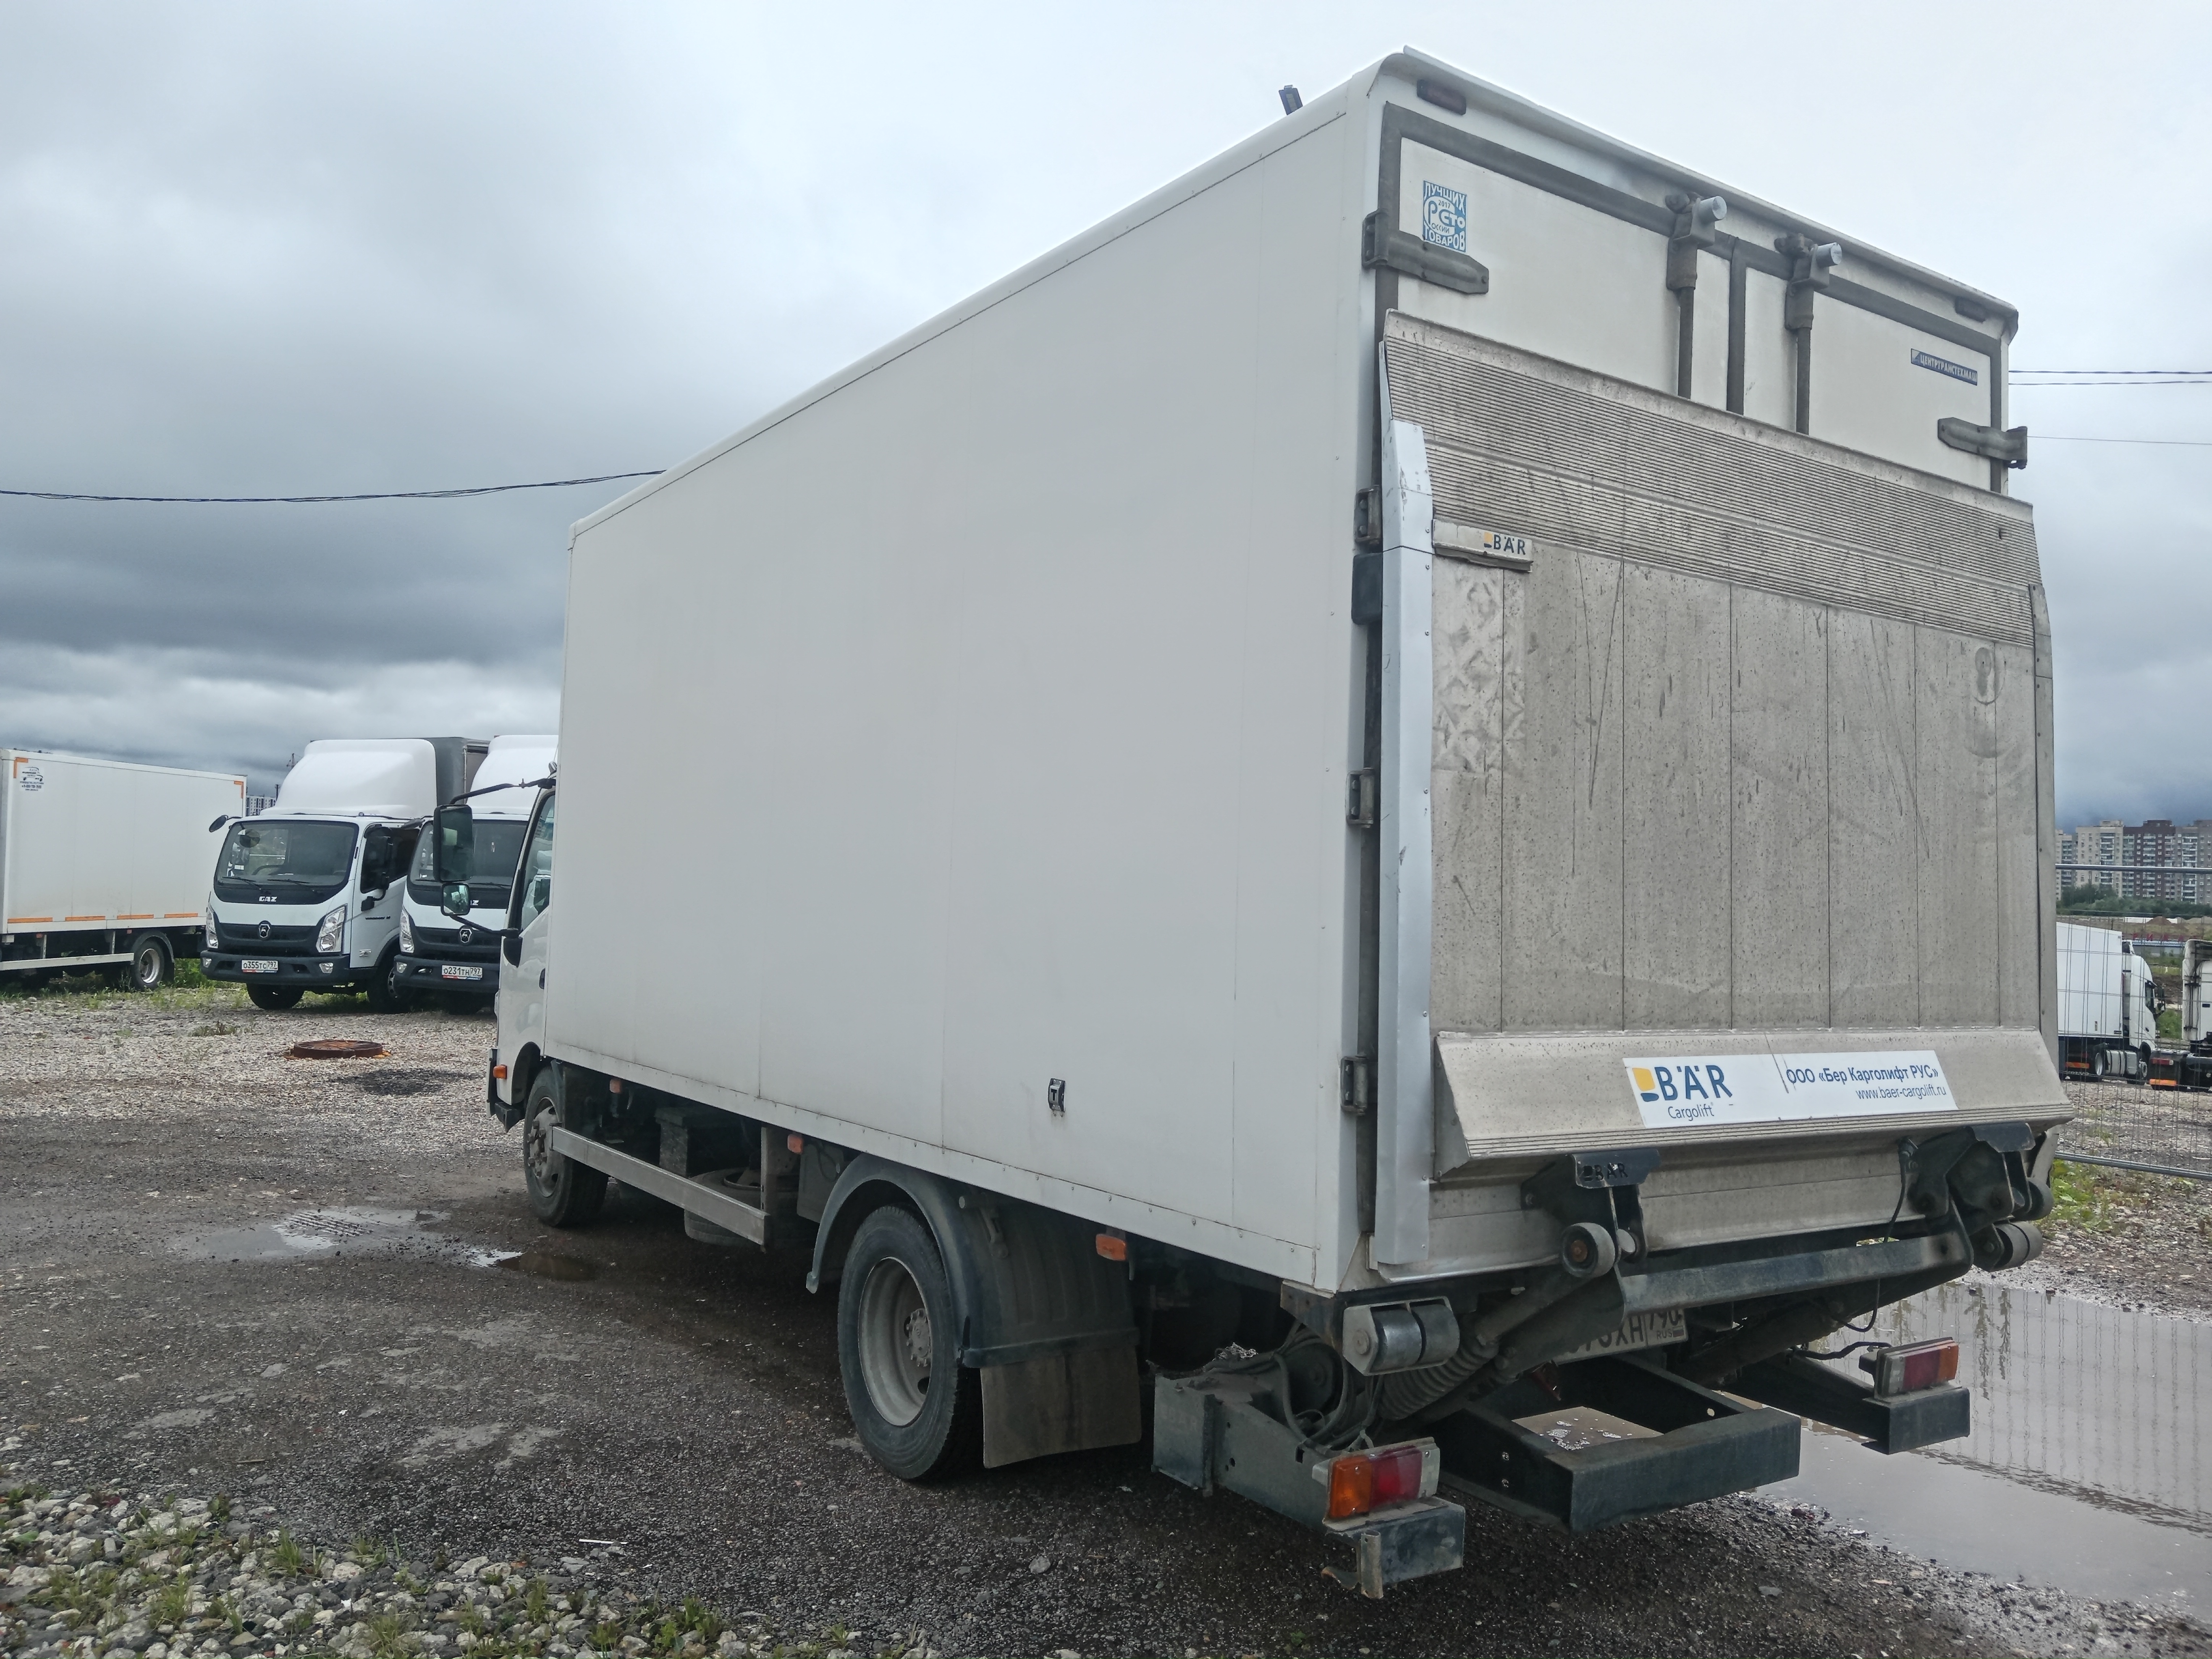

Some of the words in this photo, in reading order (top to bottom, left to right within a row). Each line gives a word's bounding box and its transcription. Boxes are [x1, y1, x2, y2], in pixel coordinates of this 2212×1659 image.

[1424, 182, 1465, 215] ЛУЧШИХ
[1438, 200, 1450, 209] 2017
[1424, 221, 1465, 251] ТОВАРОВ
[1920, 354, 1977, 382] ЦЕНТРТРАНСТЕХМАШ
[1494, 534, 1526, 555] BÄR
[1654, 1065, 1733, 1101] BÄR
[1786, 1068, 1815, 1083] ООО
[1819, 1068, 1847, 1085] «Бер
[1848, 1066, 1908, 1084] Карголифт
[1910, 1064, 1938, 1079] РУС»
[1856, 1084, 1947, 1100] www.baer-cargolift.ru
[1668, 1103, 1714, 1121] Cargolift
[1656, 1329, 1673, 1340] RUS
